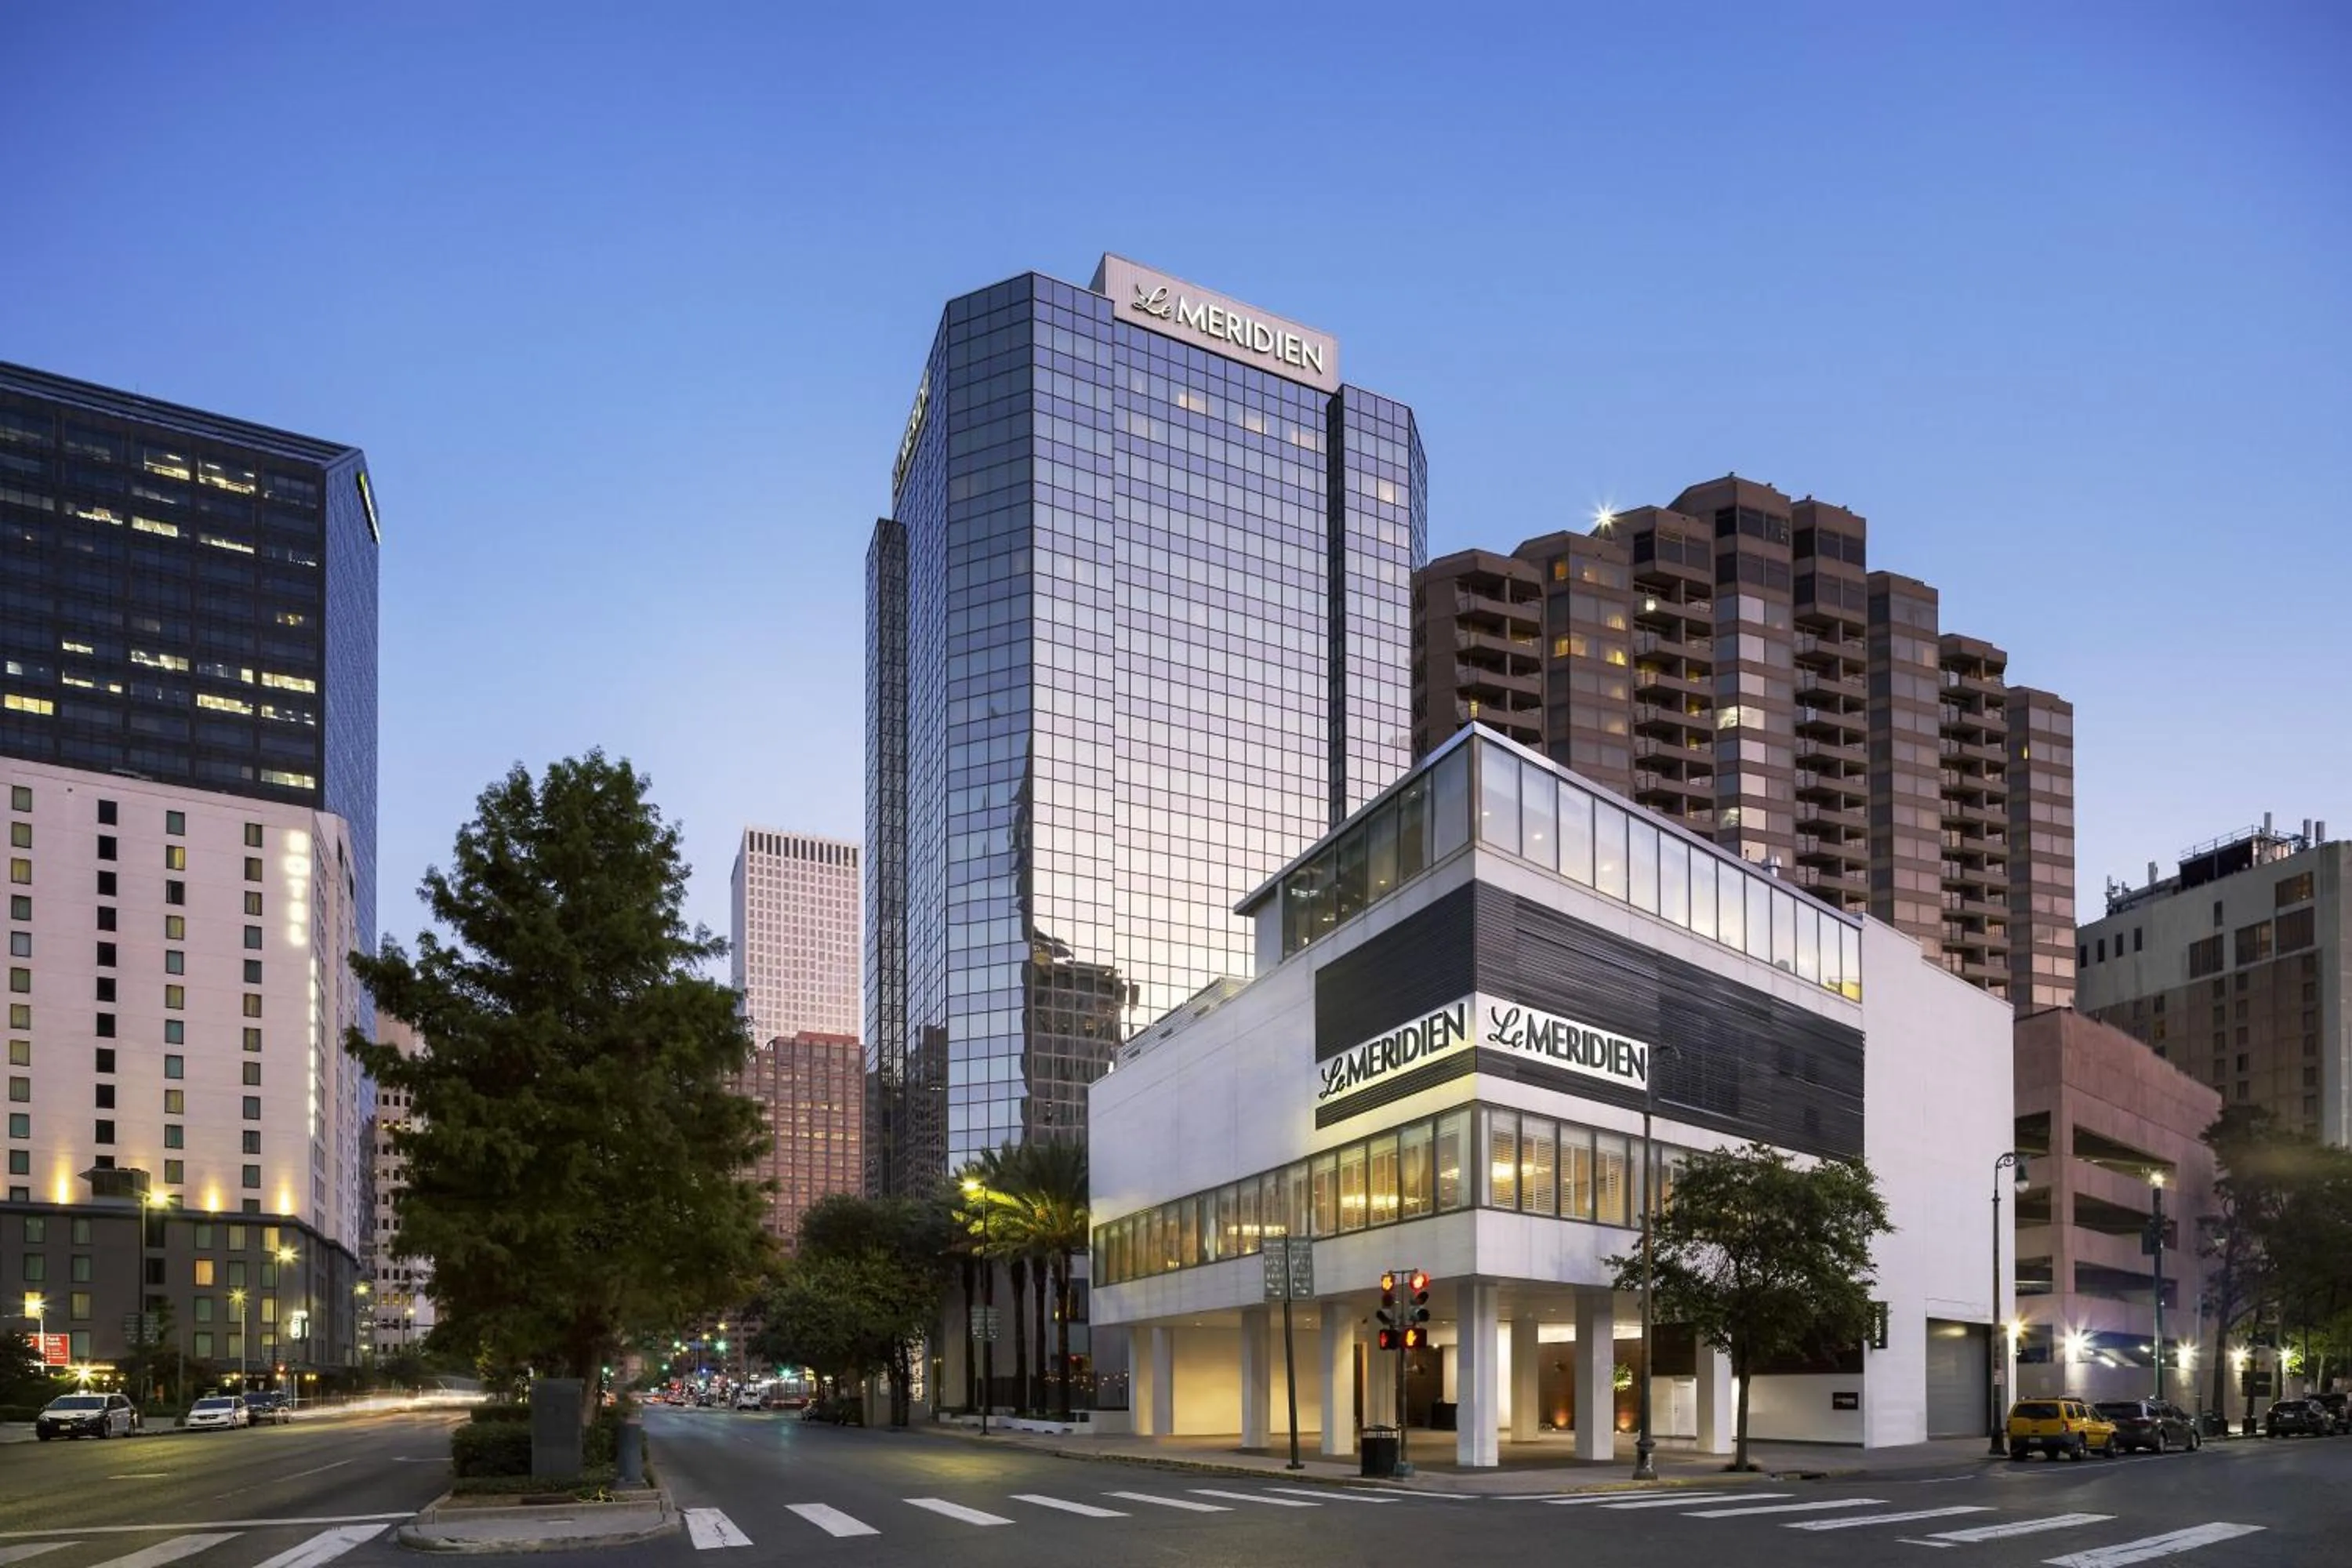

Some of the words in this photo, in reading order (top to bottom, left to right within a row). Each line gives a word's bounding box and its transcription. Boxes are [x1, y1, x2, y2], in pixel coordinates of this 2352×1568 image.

[1131, 284, 1171, 319] Le
[1176, 296, 1323, 375] MERIDIEN
[1319, 1056, 1346, 1100] Le
[1347, 1003, 1465, 1087] MERIDIEN
[1487, 1007, 1523, 1047] Le
[1526, 1013, 1646, 1082] MERIDIEN
